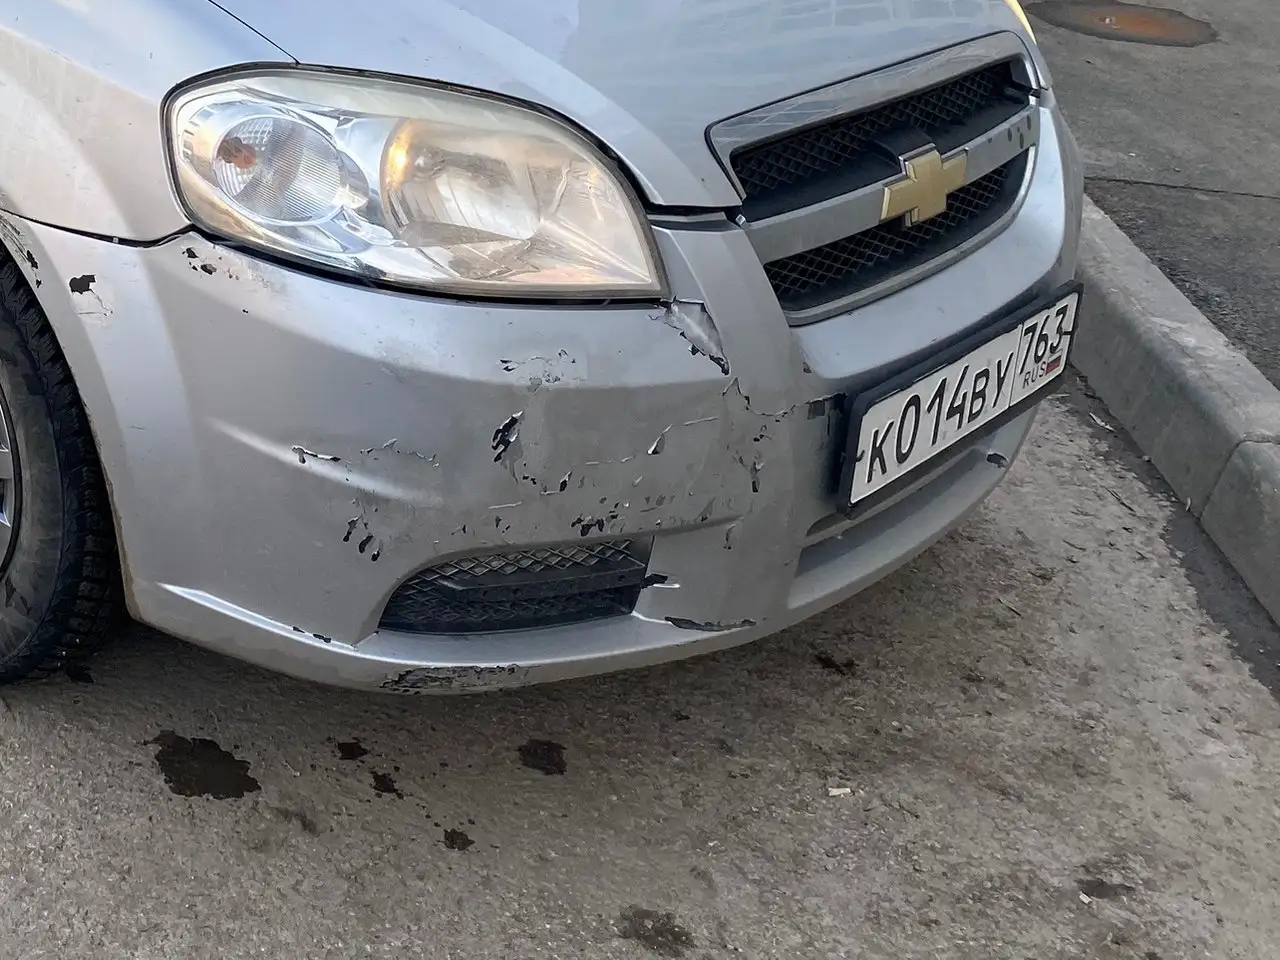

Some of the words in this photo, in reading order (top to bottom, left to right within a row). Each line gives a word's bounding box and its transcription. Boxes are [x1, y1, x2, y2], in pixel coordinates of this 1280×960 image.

[866, 351, 1014, 484] К014ВУ
[1019, 304, 1068, 375] 763
[1022, 360, 1048, 389] RUS
